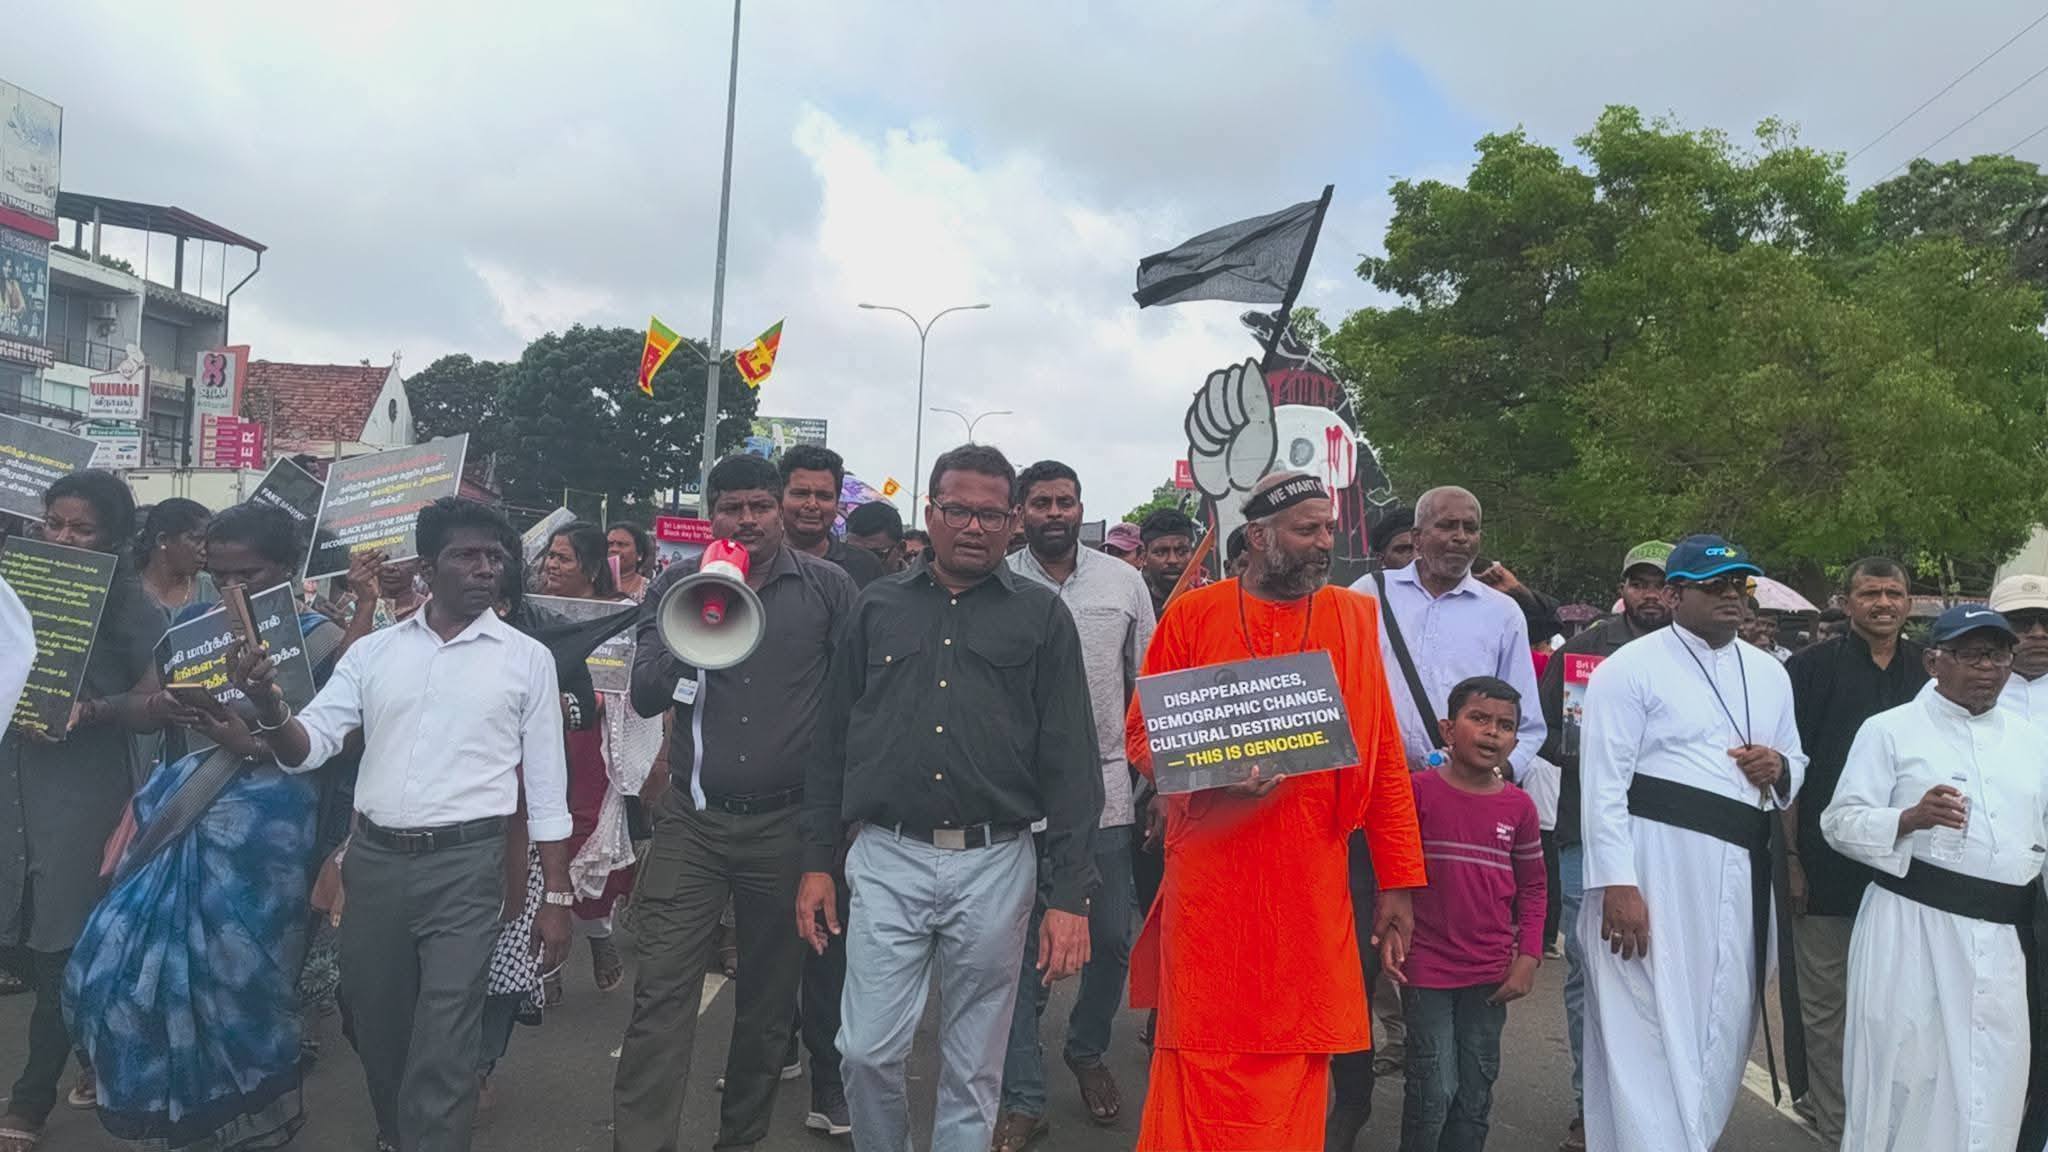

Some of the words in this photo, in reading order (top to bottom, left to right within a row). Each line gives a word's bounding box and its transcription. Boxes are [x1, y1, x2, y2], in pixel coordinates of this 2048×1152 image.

[1266, 488, 1287, 505] WE
[1285, 480, 1317, 496] WANT
[1163, 672, 1307, 708] DISAPPEARANCES,
[1147, 699, 1262, 732] DEMOGRAPHIC
[1263, 688, 1333, 711] CHANGE,
[1149, 726, 1230, 753] CULTURAL
[1230, 706, 1340, 738] DESTRUCTION
[1186, 745, 1224, 768] THIS
[1225, 743, 1243, 761] IS
[1244, 731, 1329, 757] GENOCIDE.
